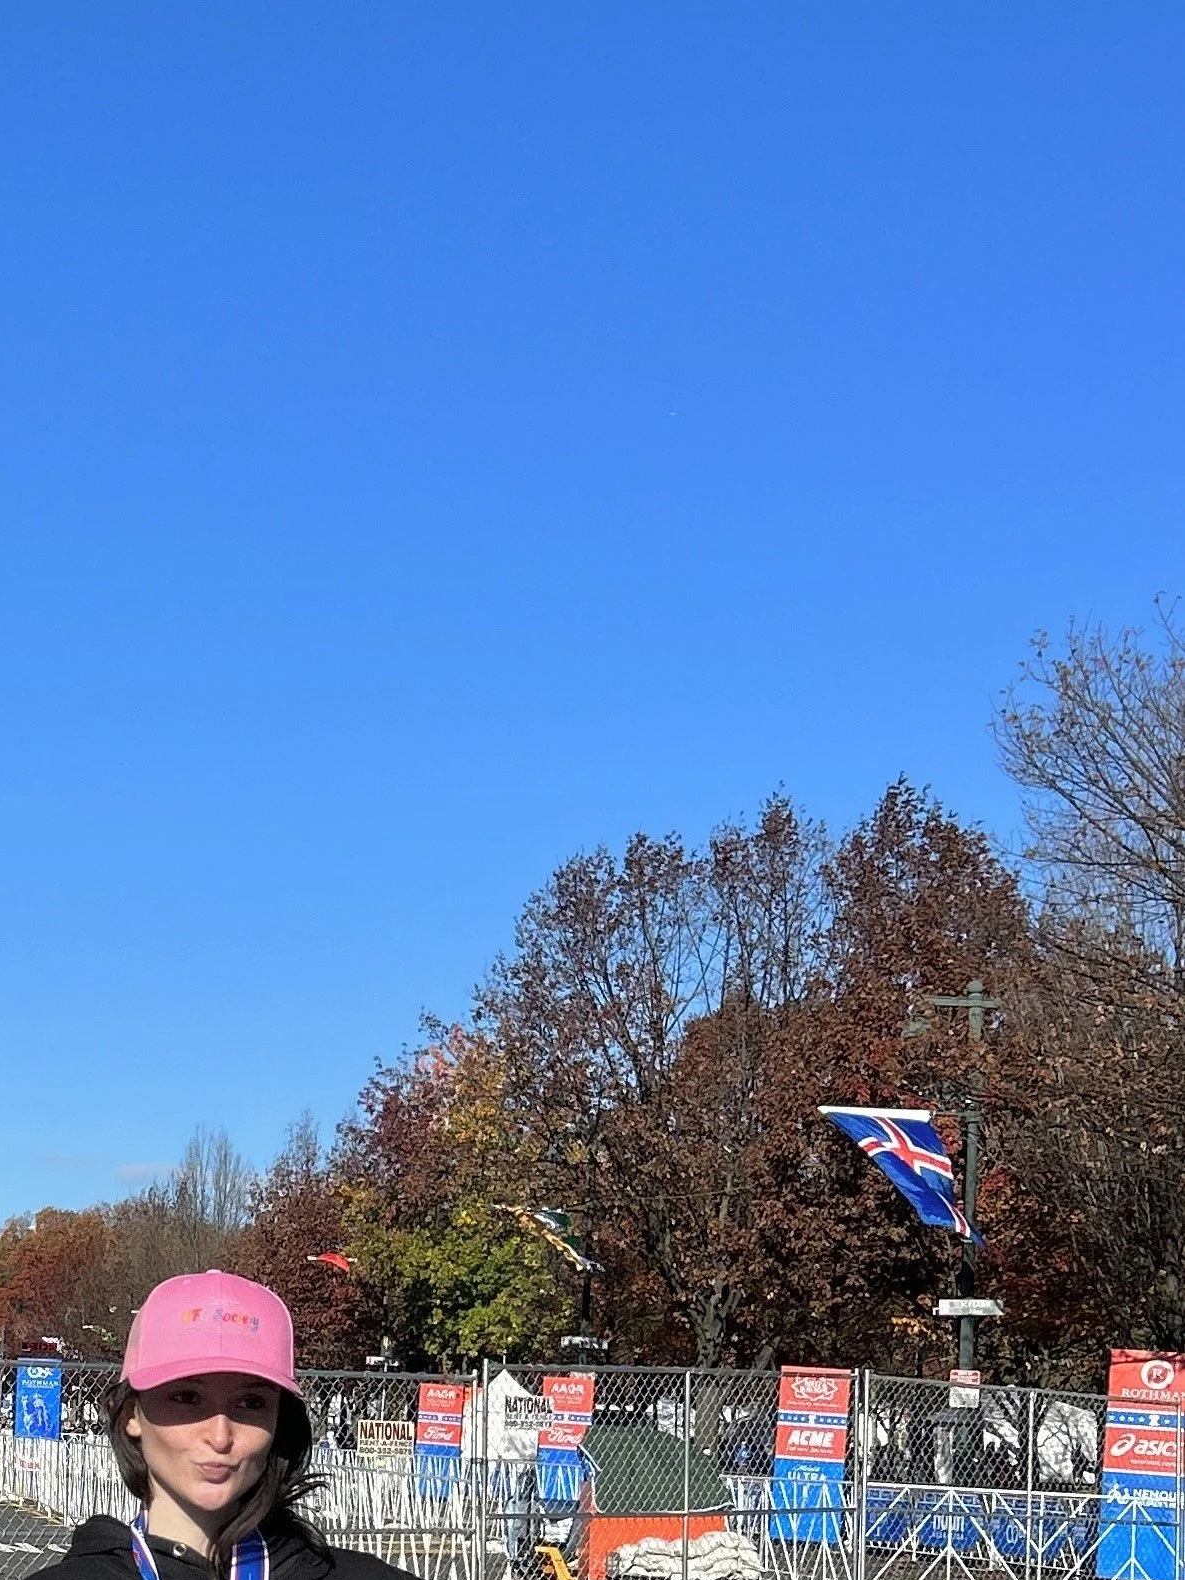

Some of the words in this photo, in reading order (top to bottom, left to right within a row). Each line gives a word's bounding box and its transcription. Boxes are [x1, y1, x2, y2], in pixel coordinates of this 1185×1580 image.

[1152, 1367, 1163, 1379] R
[504, 1395, 553, 1414] NATIONAL
[359, 1421, 413, 1441] NATIONAL
[787, 1429, 835, 1448] ACME
[787, 1470, 828, 1481] ULTRA
